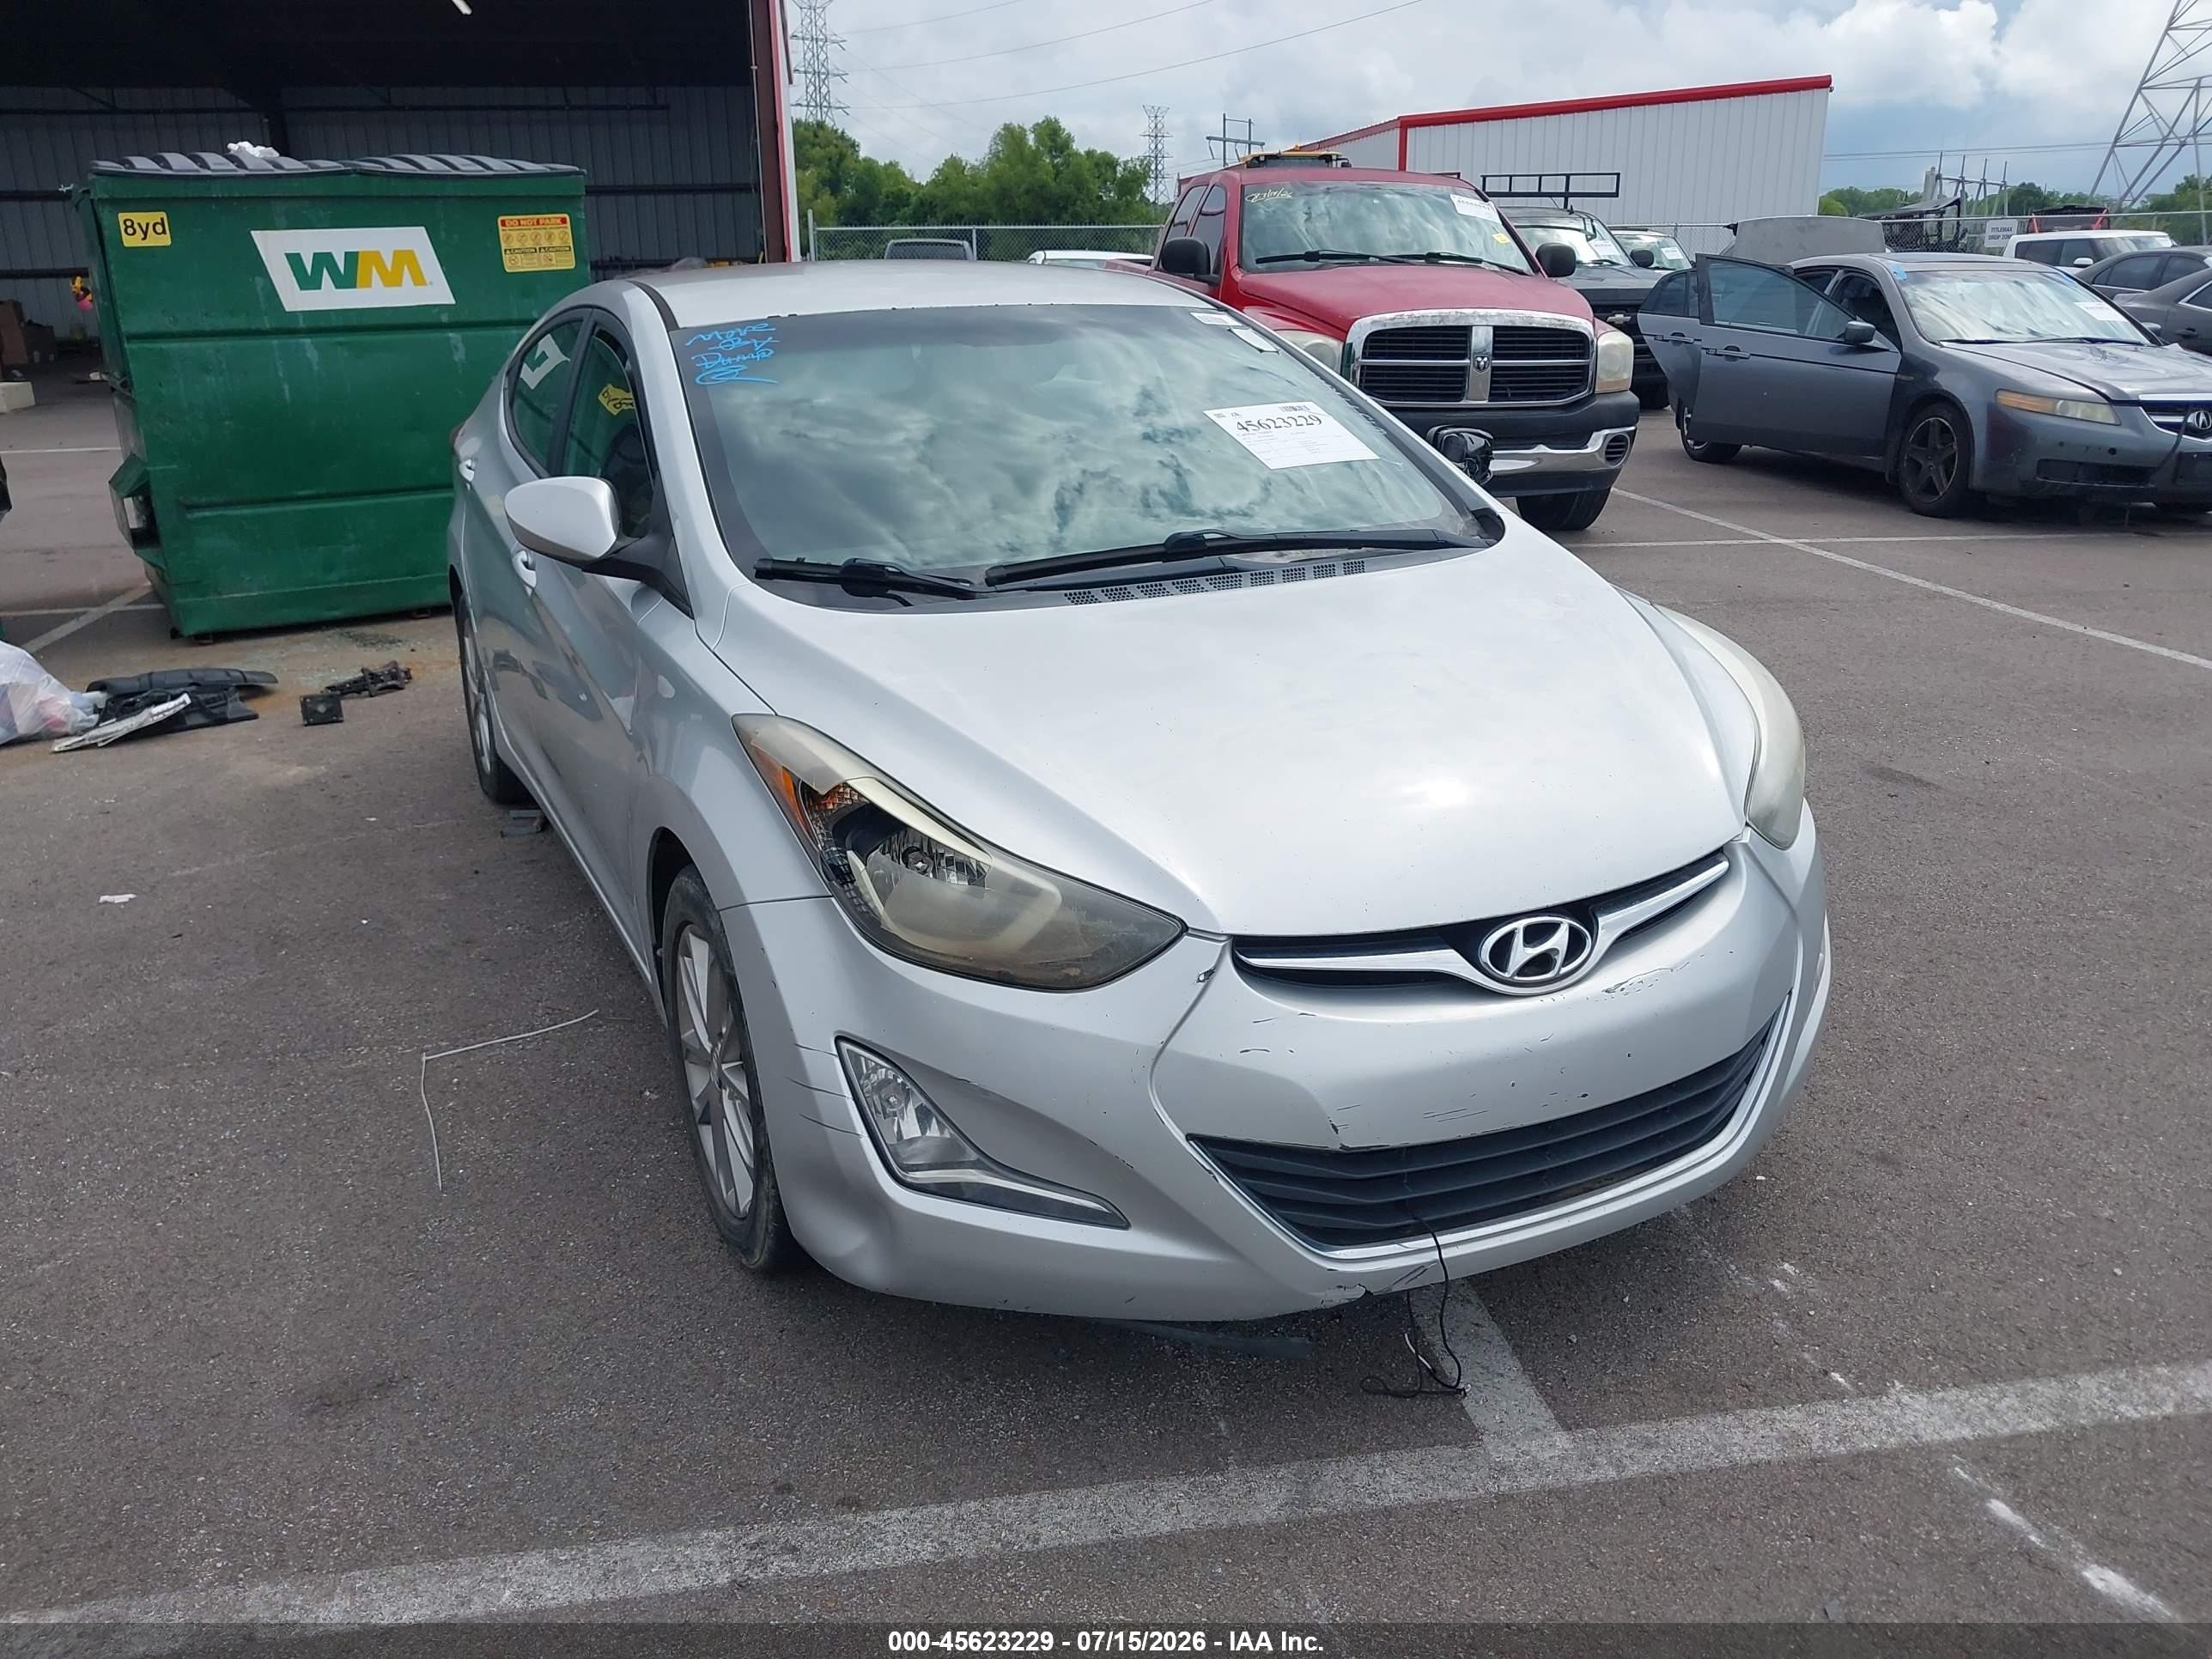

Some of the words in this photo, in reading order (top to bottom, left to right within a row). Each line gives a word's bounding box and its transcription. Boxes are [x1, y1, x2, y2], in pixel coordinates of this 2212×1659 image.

[123, 217, 167, 240] 8yd
[284, 249, 428, 290] WM
[1237, 414, 1322, 432] 45623229
